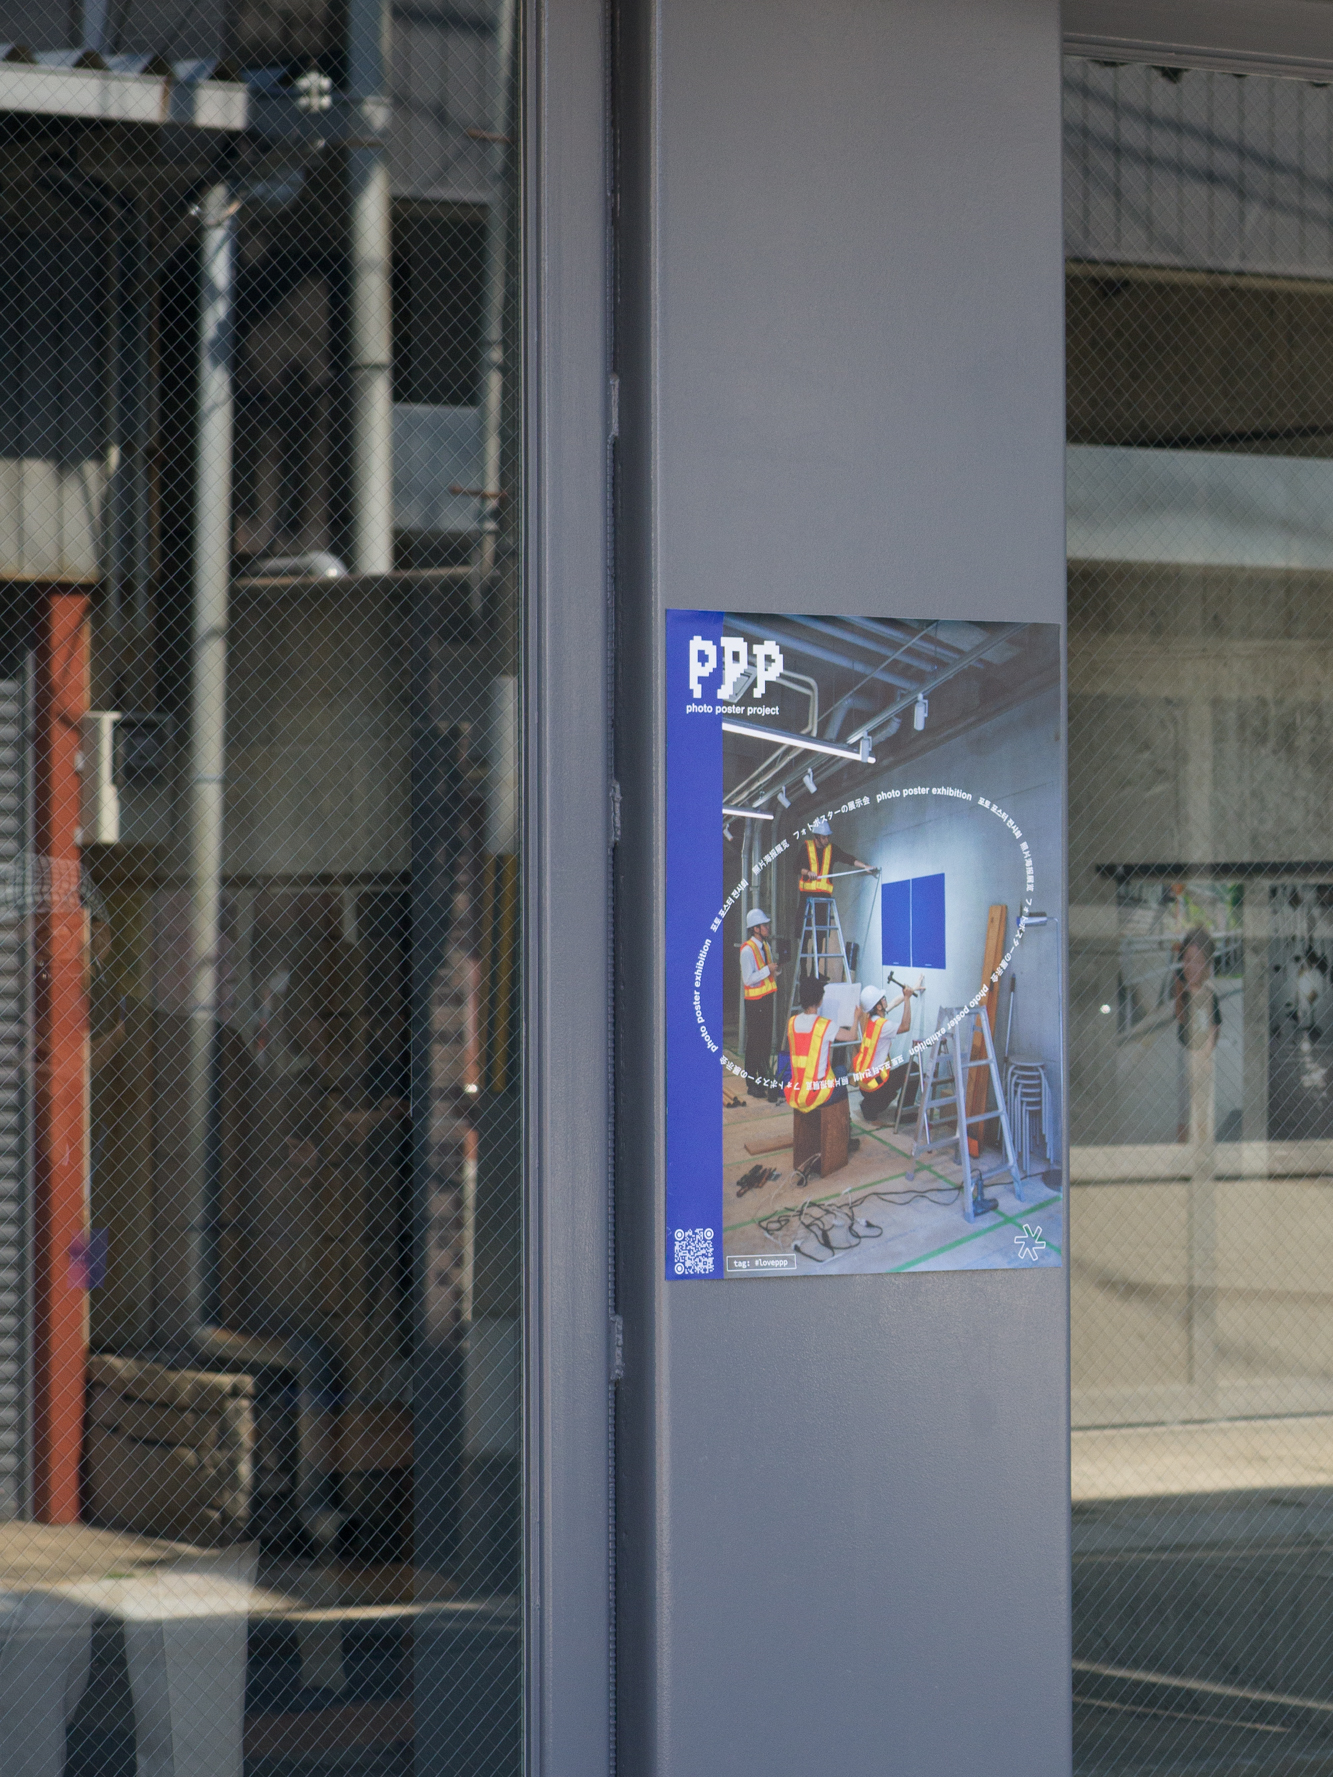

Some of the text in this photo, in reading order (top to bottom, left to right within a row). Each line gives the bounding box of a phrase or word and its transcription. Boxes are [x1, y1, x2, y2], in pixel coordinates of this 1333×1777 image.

[686, 703, 780, 716] photo poster project
[876, 786, 973, 803] photo poster exhibition
[793, 795, 871, 840] フォトポスターの展示会
[693, 938, 719, 1053] photo poster exhibition
[908, 983, 989, 1056] photo poster exhibition
[733, 1258, 788, 1268] tag: #loveppp
